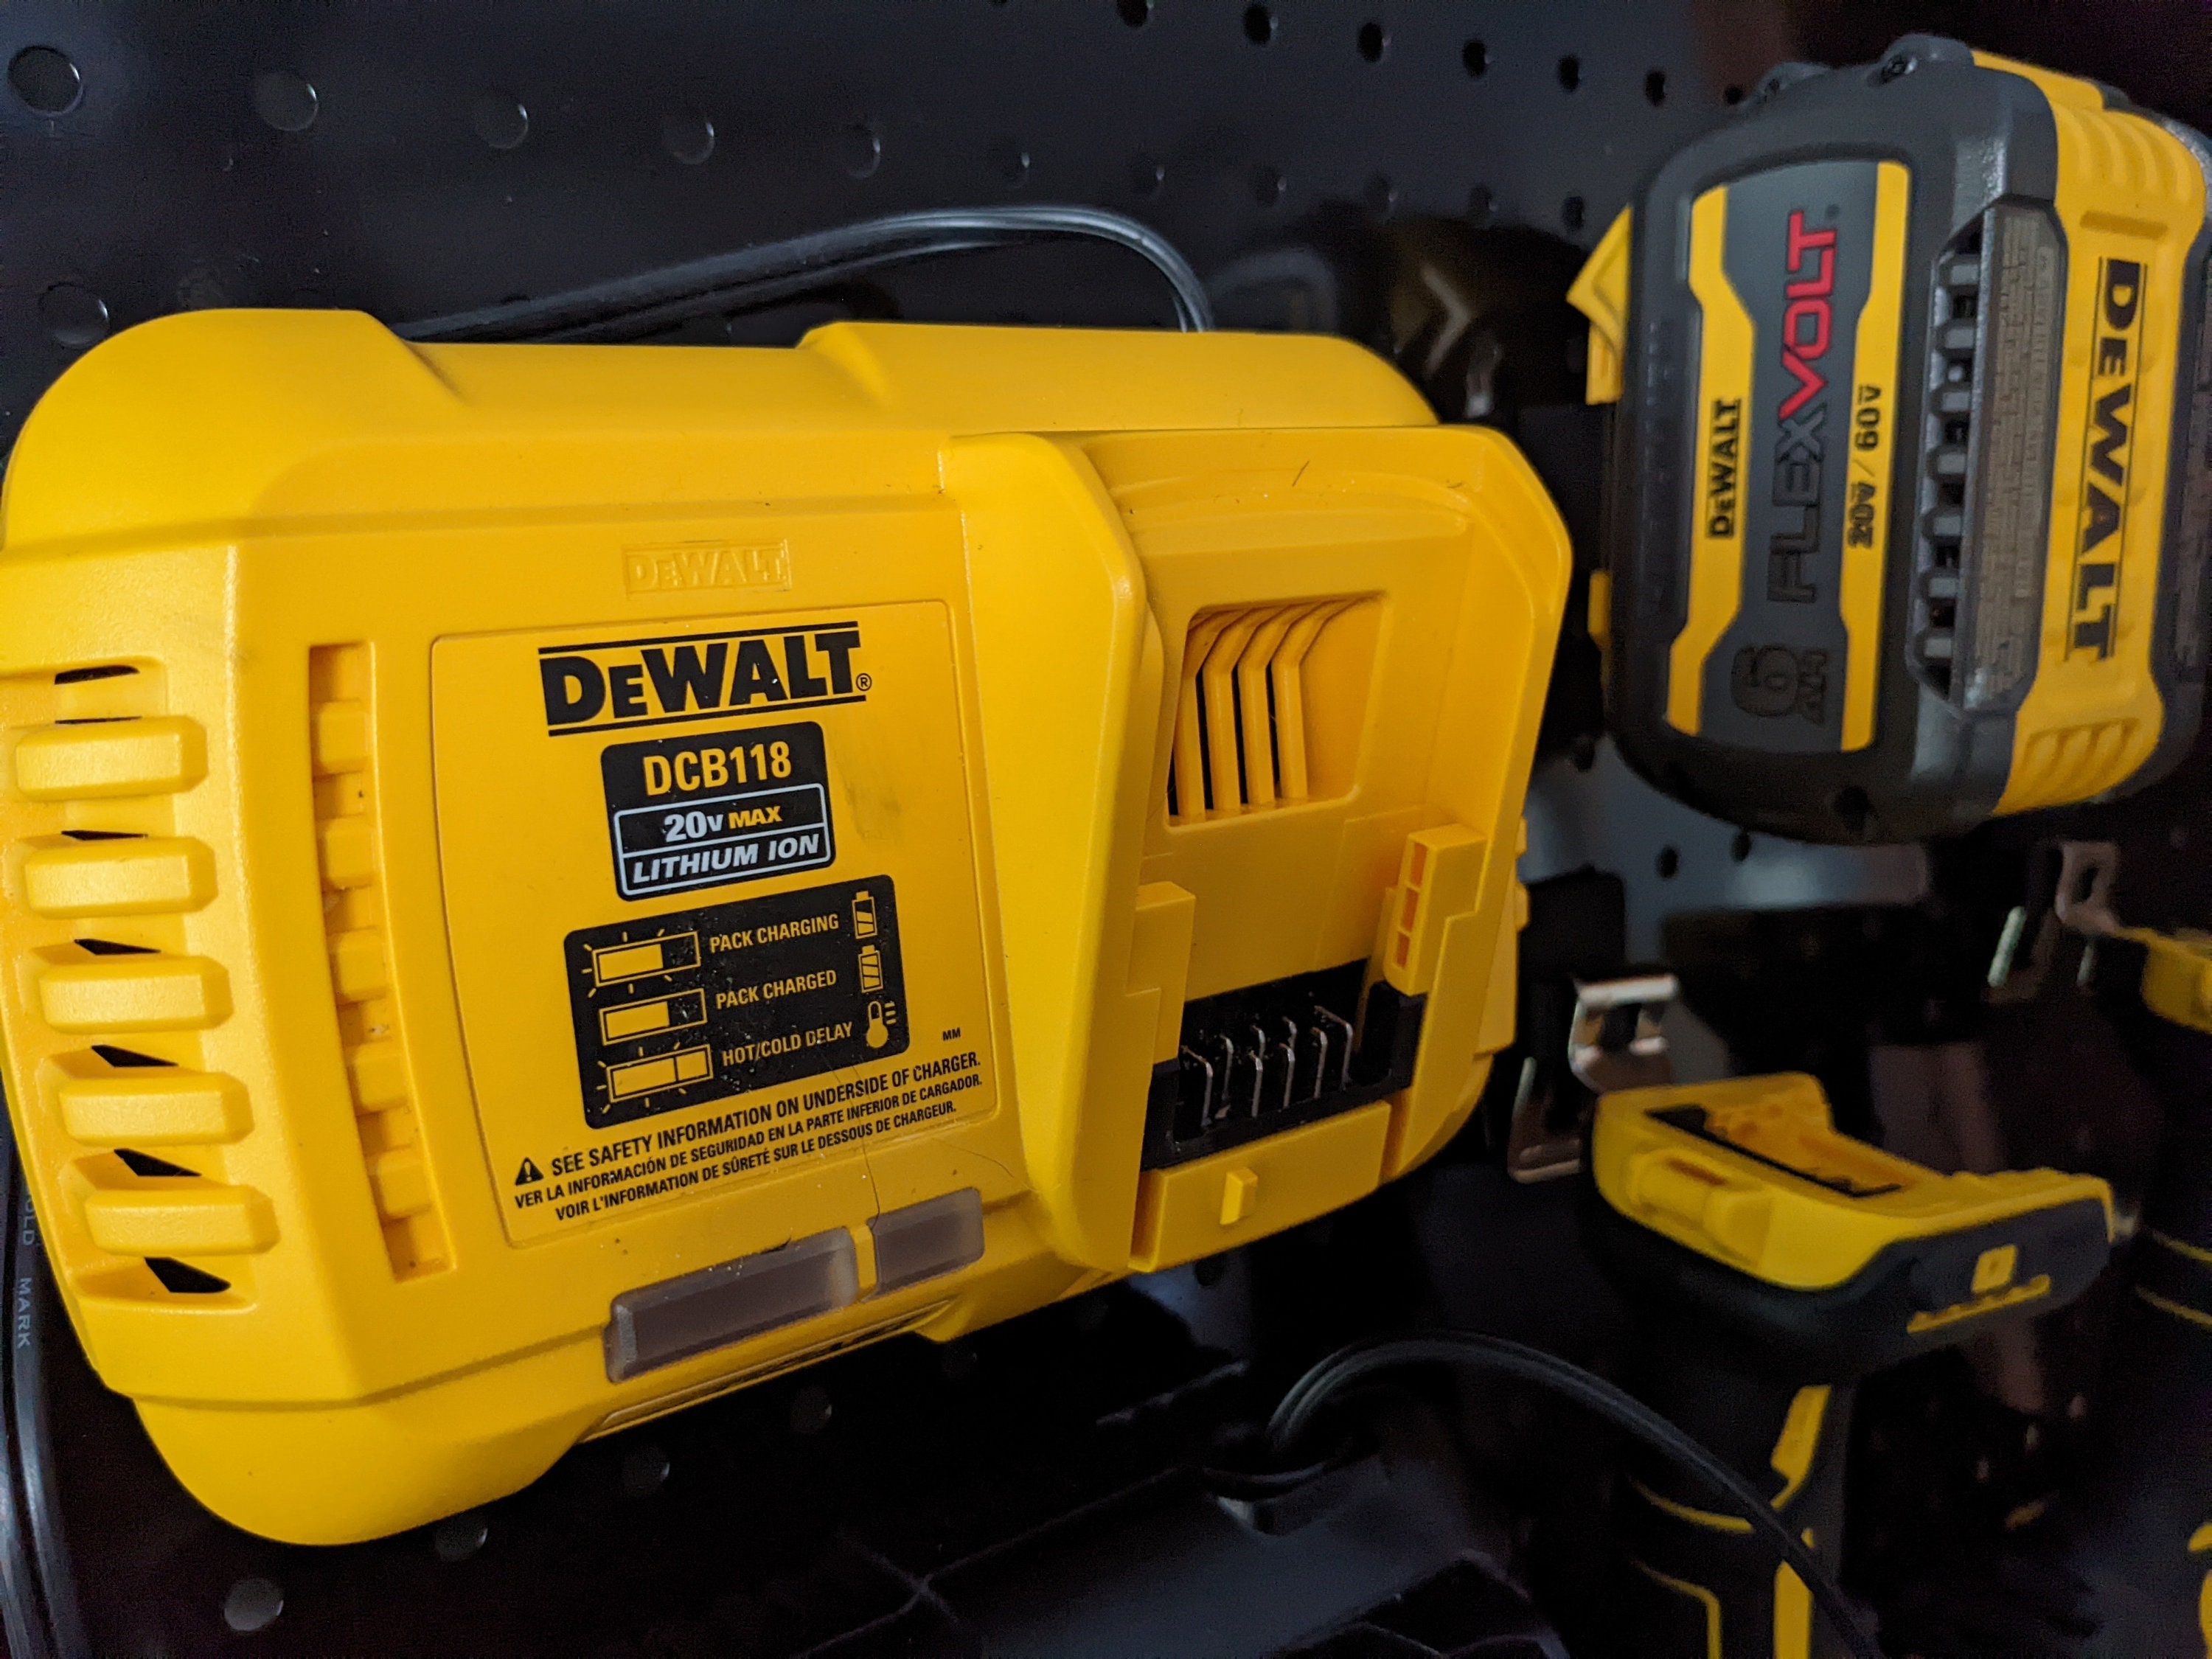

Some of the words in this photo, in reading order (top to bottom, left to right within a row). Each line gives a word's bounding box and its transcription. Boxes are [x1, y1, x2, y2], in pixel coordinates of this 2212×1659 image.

[1767, 209, 1837, 604] FLEXVOLT
[643, 741, 792, 796] DCB118
[728, 806, 783, 830] MAX
[633, 844, 759, 883] LITHIUM
[768, 834, 820, 861] ION
[709, 930, 754, 953] PACK
[757, 914, 839, 944] CHARGING
[715, 986, 759, 1009] PACK
[762, 970, 837, 999] CHARGED
[722, 1035, 801, 1066] HOT/COLD
[805, 1021, 852, 1046] DELAY
[942, 1027, 961, 1041] MM
[552, 1152, 585, 1176] SEE
[589, 1134, 652, 1167] SAFETY
[658, 1106, 771, 1150] INFORMATION
[776, 1096, 799, 1118] ON
[804, 1074, 888, 1110] UNDERSIDE
[891, 1068, 910, 1088] OF
[913, 1051, 981, 1082] CHARGER.
[514, 1188, 544, 1208] VER
[546, 1184, 566, 1201] LA
[568, 1156, 667, 1196] INFORMACIÓN
[671, 1150, 689, 1168] DE
[692, 1130, 765, 1161] SEGURIDAD
[768, 1126, 785, 1141] EN
[788, 1121, 804, 1136] LA
[807, 1110, 844, 1132] PARTE
[847, 1096, 900, 1121] INFERIOR
[902, 1089, 917, 1106] DE
[919, 1074, 983, 1101] CARGADOR.
[555, 1202, 590, 1221] VOIR
[593, 1173, 699, 1212] L'INFORMATION
[703, 1164, 719, 1182] DE
[723, 1148, 771, 1176] SÛRETÉ
[774, 1143, 799, 1162] SUR
[801, 1138, 815, 1154] LE
[818, 1124, 873, 1150] DESSOUS
[876, 1117, 891, 1134] DE
[894, 1100, 957, 1128] CHARGEUR.
[17, 1277, 31, 1348] MARK
